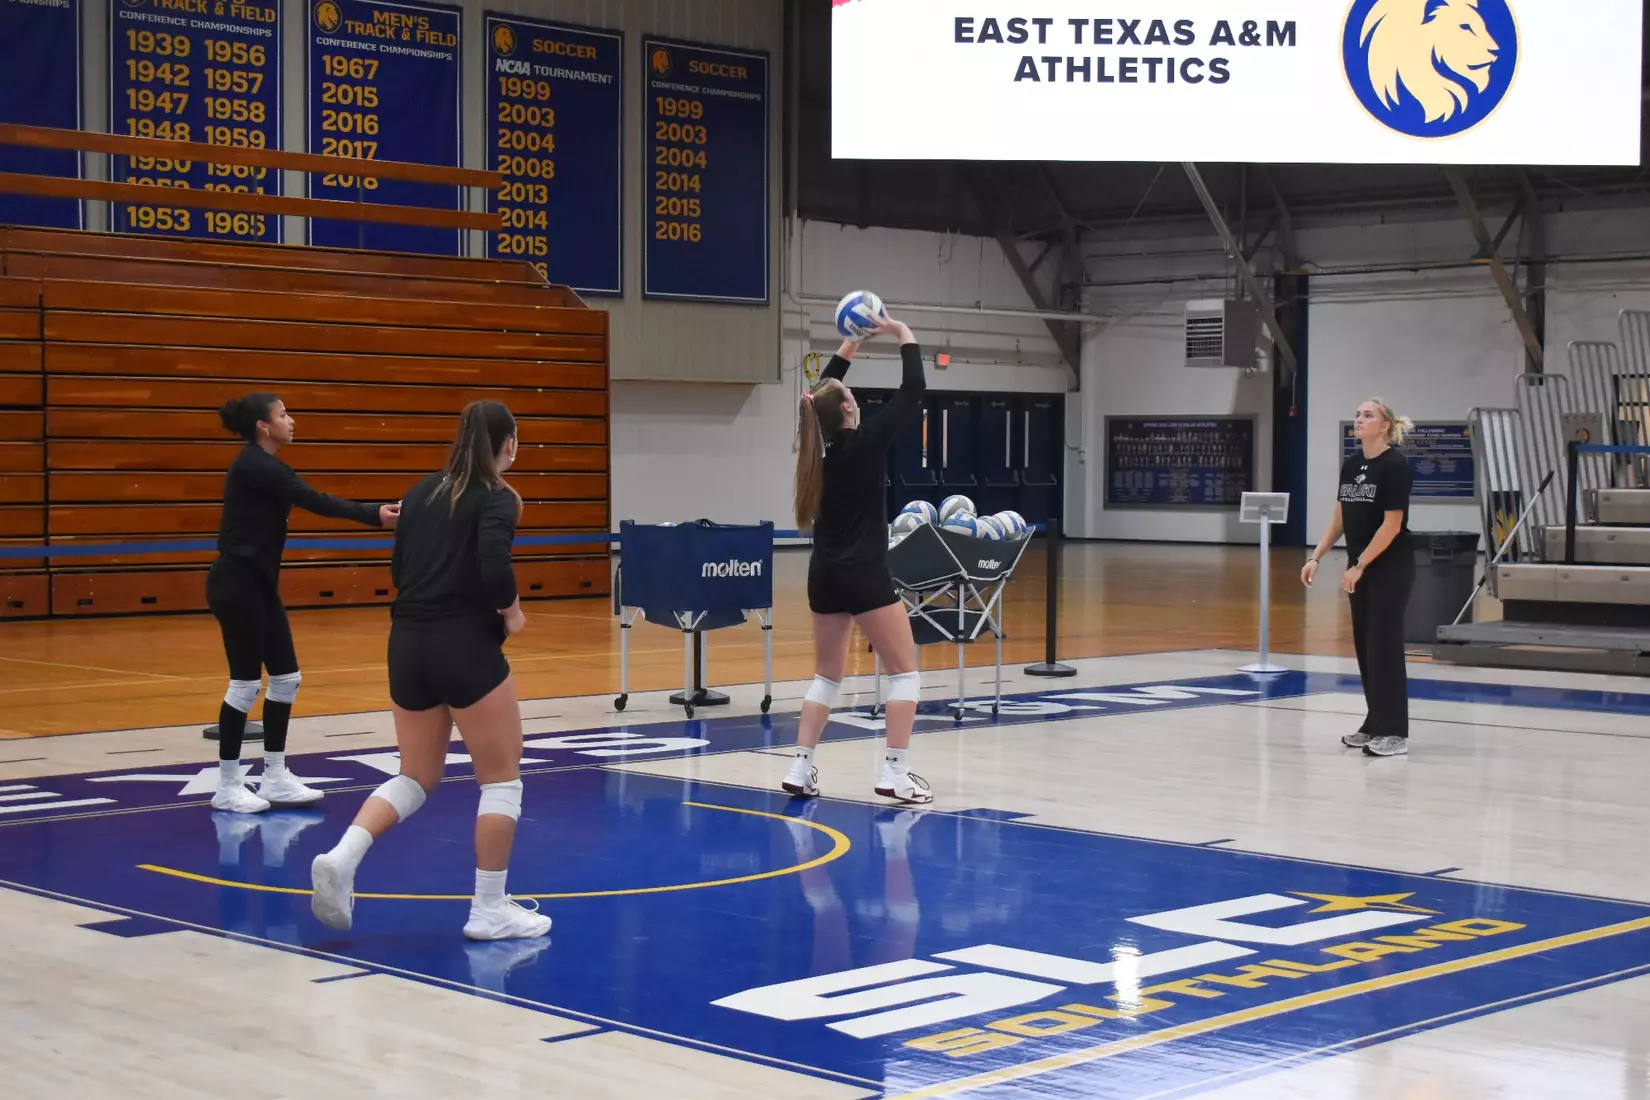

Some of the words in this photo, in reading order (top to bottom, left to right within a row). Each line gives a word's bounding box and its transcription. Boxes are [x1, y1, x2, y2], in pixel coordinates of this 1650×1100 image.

[119, 10, 187, 27] CONFERENCE
[190, 20, 272, 37] CHAMPIONSHIPS
[215, 3, 224, 16] &
[231, 6, 276, 22] FIELD
[373, 10, 430, 30] MEN'S
[126, 29, 191, 57] 1939
[345, 20, 395, 40] TRACK
[401, 26, 411, 41] &
[416, 30, 457, 47] FIELD
[954, 17, 1054, 44] EAST
[1068, 18, 1196, 46] TEXAS
[1209, 20, 1296, 47] A&M
[204, 39, 266, 66] 1956
[316, 36, 377, 51] CONFERENCE
[379, 45, 453, 60] CHAMPIONSHIPS
[532, 38, 597, 60] SOCCER
[126, 59, 191, 87] 1942
[322, 55, 379, 80] 1967
[495, 58, 531, 75] NCAA
[533, 65, 613, 84] TOURNAMENT
[688, 60, 748, 80] SOCCER
[1013, 56, 1230, 85] ATHLETICS
[204, 68, 264, 94] 1957
[499, 76, 551, 101] 1999
[651, 80, 700, 94] CONFERENCE
[702, 87, 762, 101] CHAMPIONSHIPS
[126, 88, 189, 115] 1947
[322, 82, 379, 108] 2015
[204, 97, 266, 123] 1958
[498, 102, 555, 127] 2003
[656, 97, 703, 119] 1999
[126, 118, 191, 142] 1948
[322, 109, 379, 135] 2016
[655, 121, 707, 144] 2003
[204, 126, 266, 149] 1959
[322, 137, 378, 160] 2017
[498, 128, 555, 153] 2004
[498, 154, 555, 179] 2008
[655, 146, 707, 169] 2004
[322, 174, 379, 190] 208
[498, 181, 548, 204] 2013
[655, 171, 701, 193] 2014
[126, 205, 191, 232] 1953
[499, 207, 548, 231] 2014
[655, 196, 701, 217] 2015
[204, 211, 266, 236] 1965
[655, 221, 701, 242] 2016
[497, 233, 548, 256] 2015
[1340, 483, 1377, 498] SALUKI
[701, 559, 762, 578] molten
[709, 892, 1433, 1040] SLC
[903, 917, 1527, 1058] SOUTHLAND
